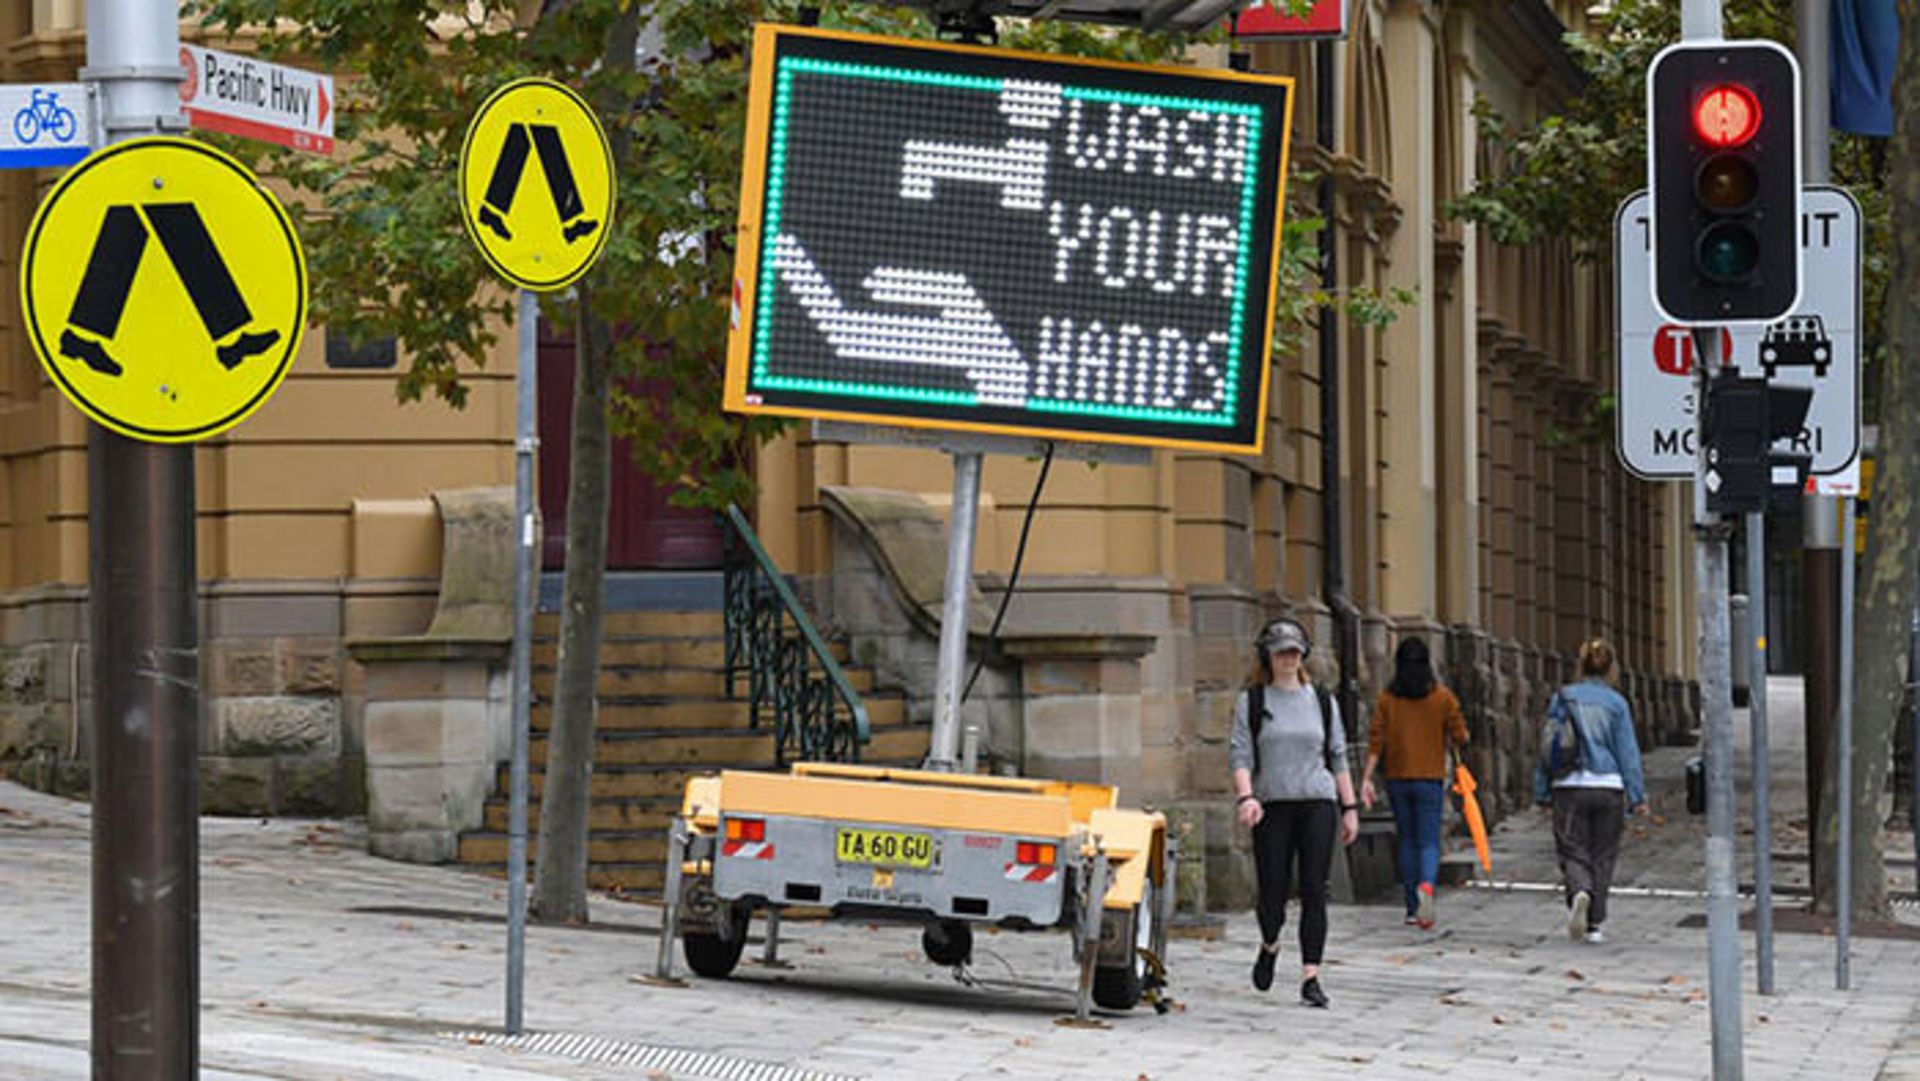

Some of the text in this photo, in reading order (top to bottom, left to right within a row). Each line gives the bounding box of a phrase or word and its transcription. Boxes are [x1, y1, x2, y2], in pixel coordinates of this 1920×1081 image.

[205, 54, 311, 126] Pacific Hwy
[1066, 98, 1247, 182] WASH
[1048, 200, 1238, 298] YOUR
[1036, 316, 1229, 410] HANDS
[842, 832, 865, 855] TA
[871, 835, 897, 857] 60
[902, 836, 929, 860] GU
